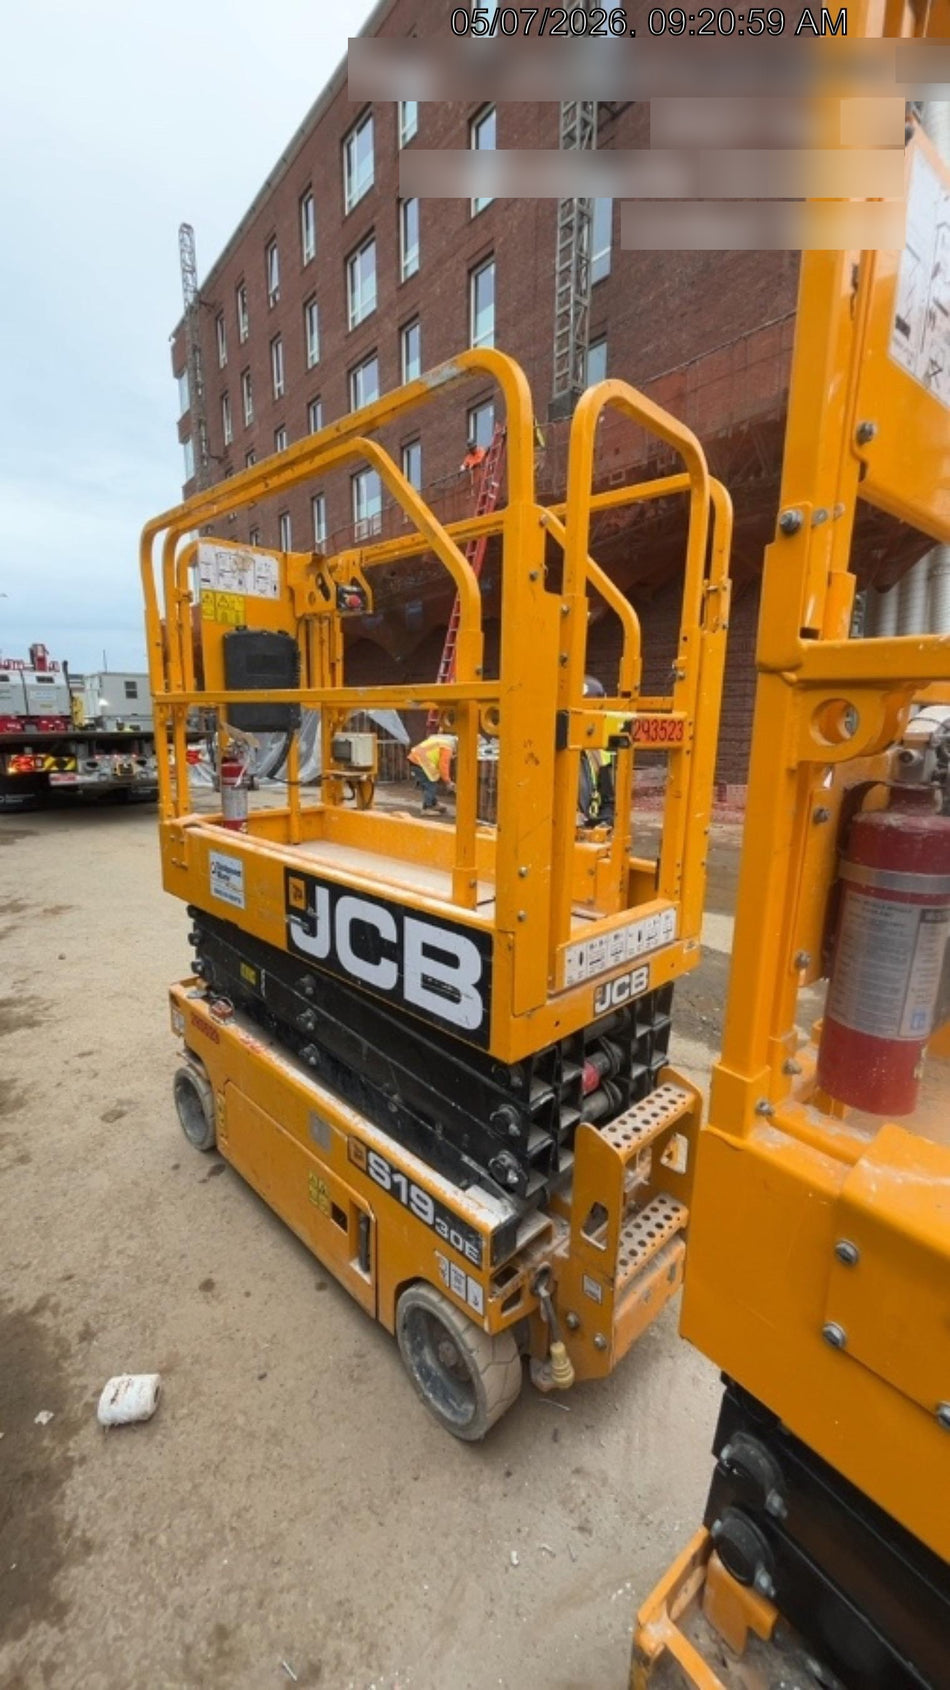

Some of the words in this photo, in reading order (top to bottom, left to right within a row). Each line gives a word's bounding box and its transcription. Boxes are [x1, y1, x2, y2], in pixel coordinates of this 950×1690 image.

[631, 717, 684, 743] 293523
[290, 885, 484, 1031] JCB
[595, 966, 649, 1013] JCB
